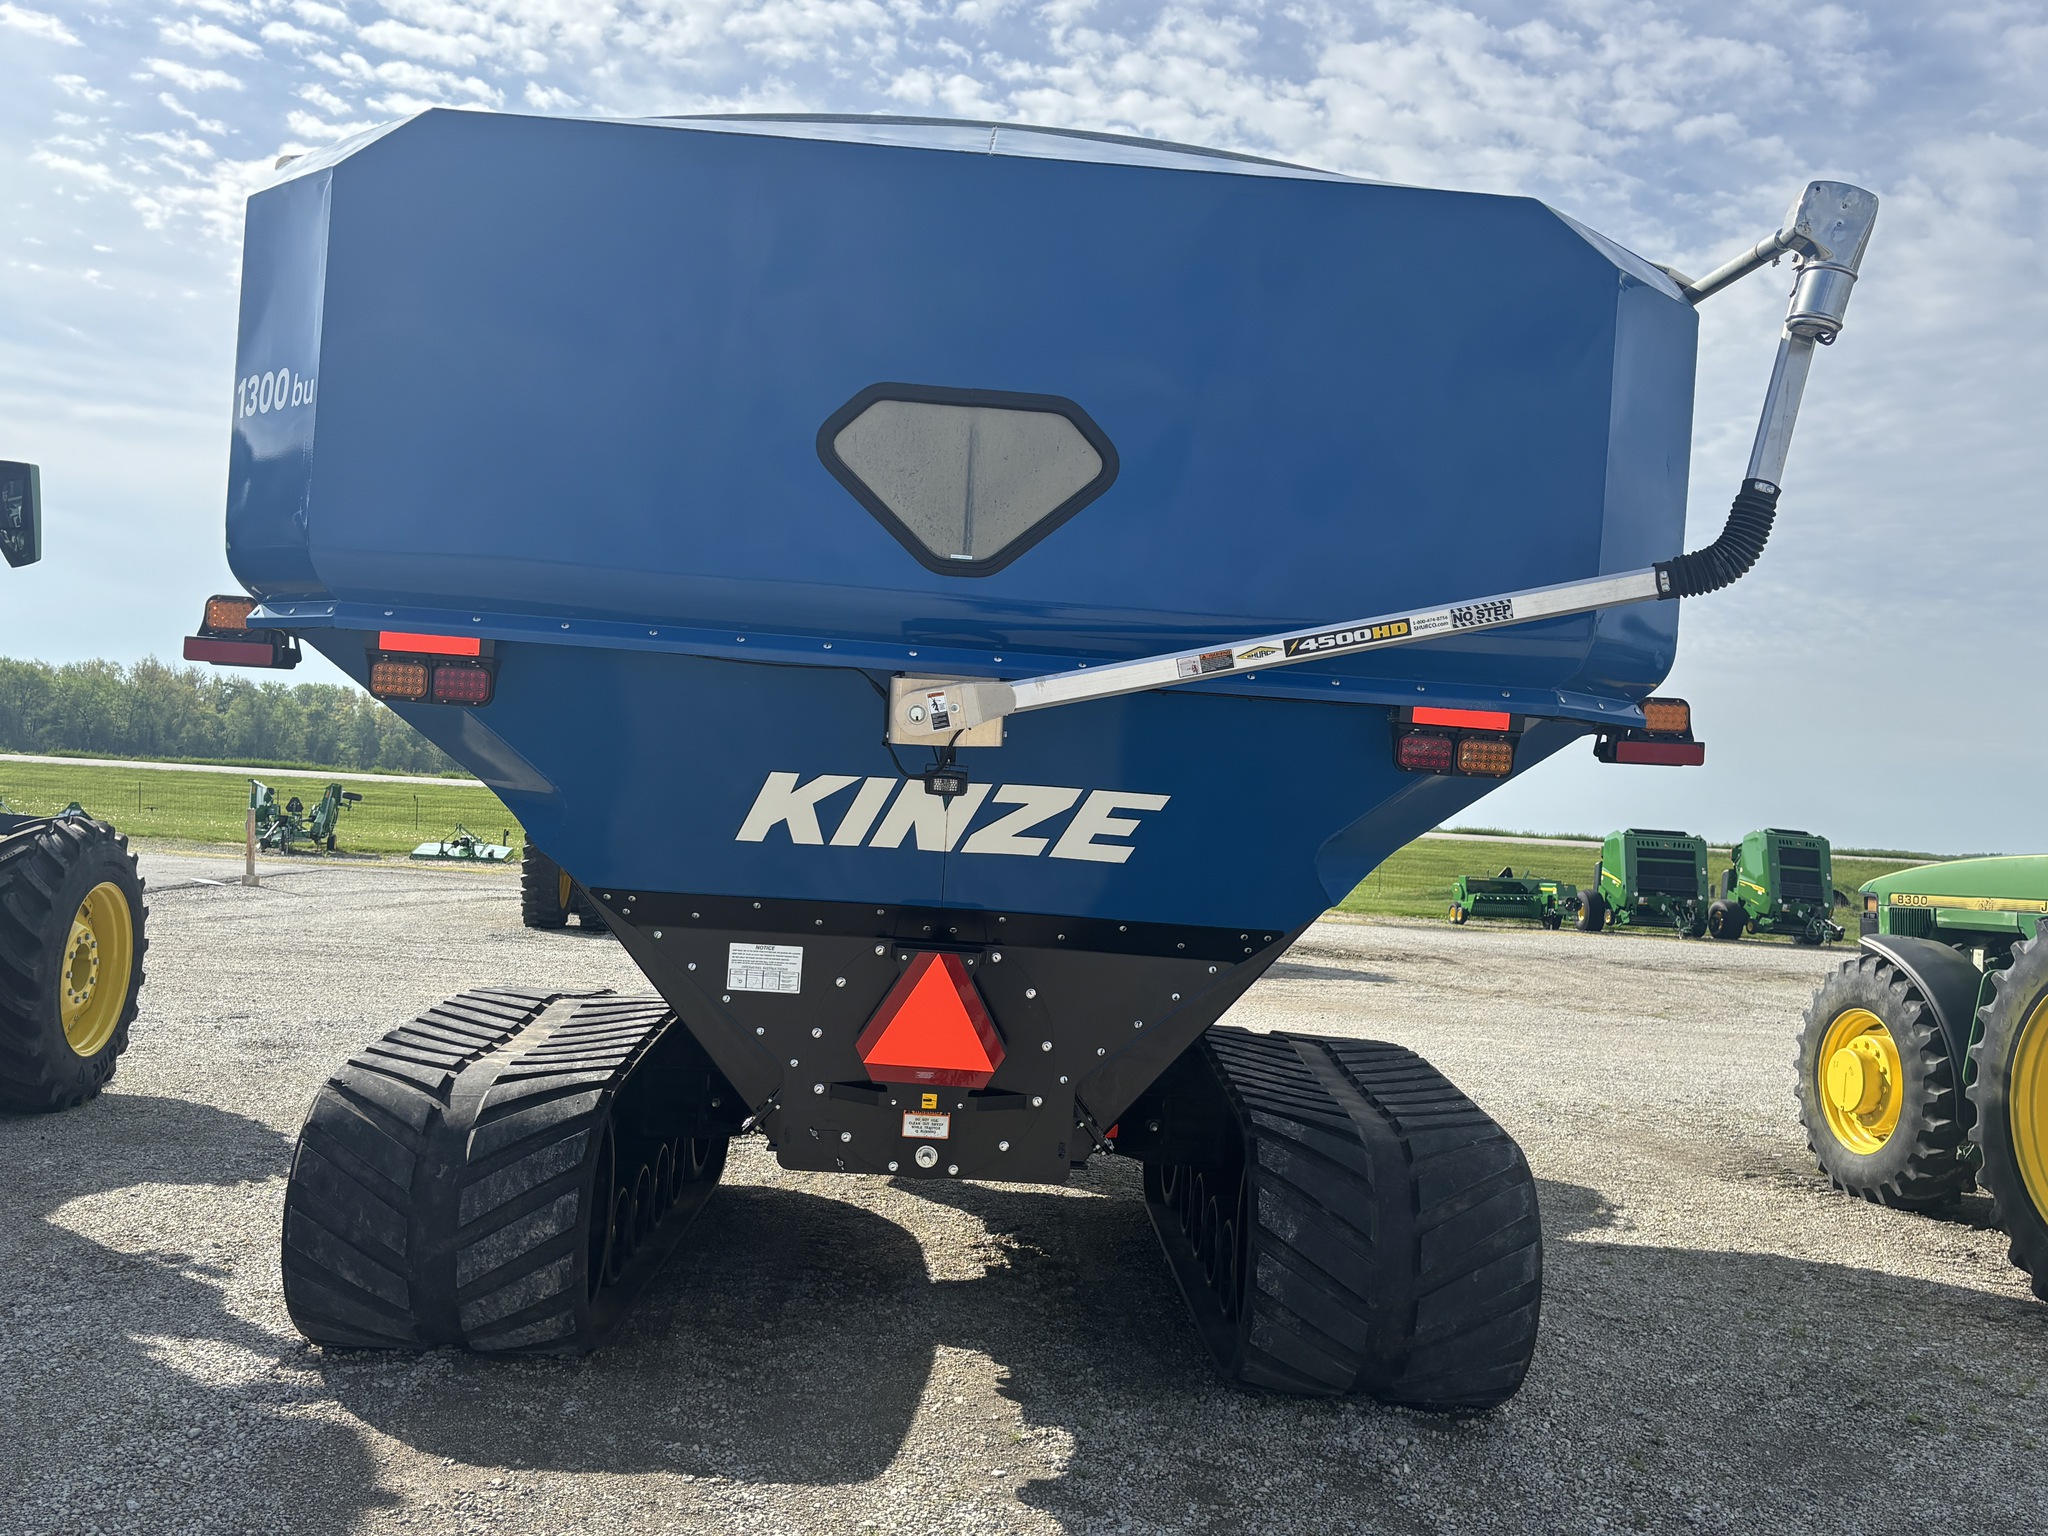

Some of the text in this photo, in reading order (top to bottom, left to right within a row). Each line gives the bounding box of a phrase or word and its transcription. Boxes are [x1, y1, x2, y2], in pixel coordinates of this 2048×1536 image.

[237, 367, 315, 419] 1300 bu
[1452, 604, 1511, 624] NO STEP
[1299, 622, 1408, 651] 4500HD
[734, 771, 1172, 863] KINZE
[1897, 894, 1928, 906] 8300
